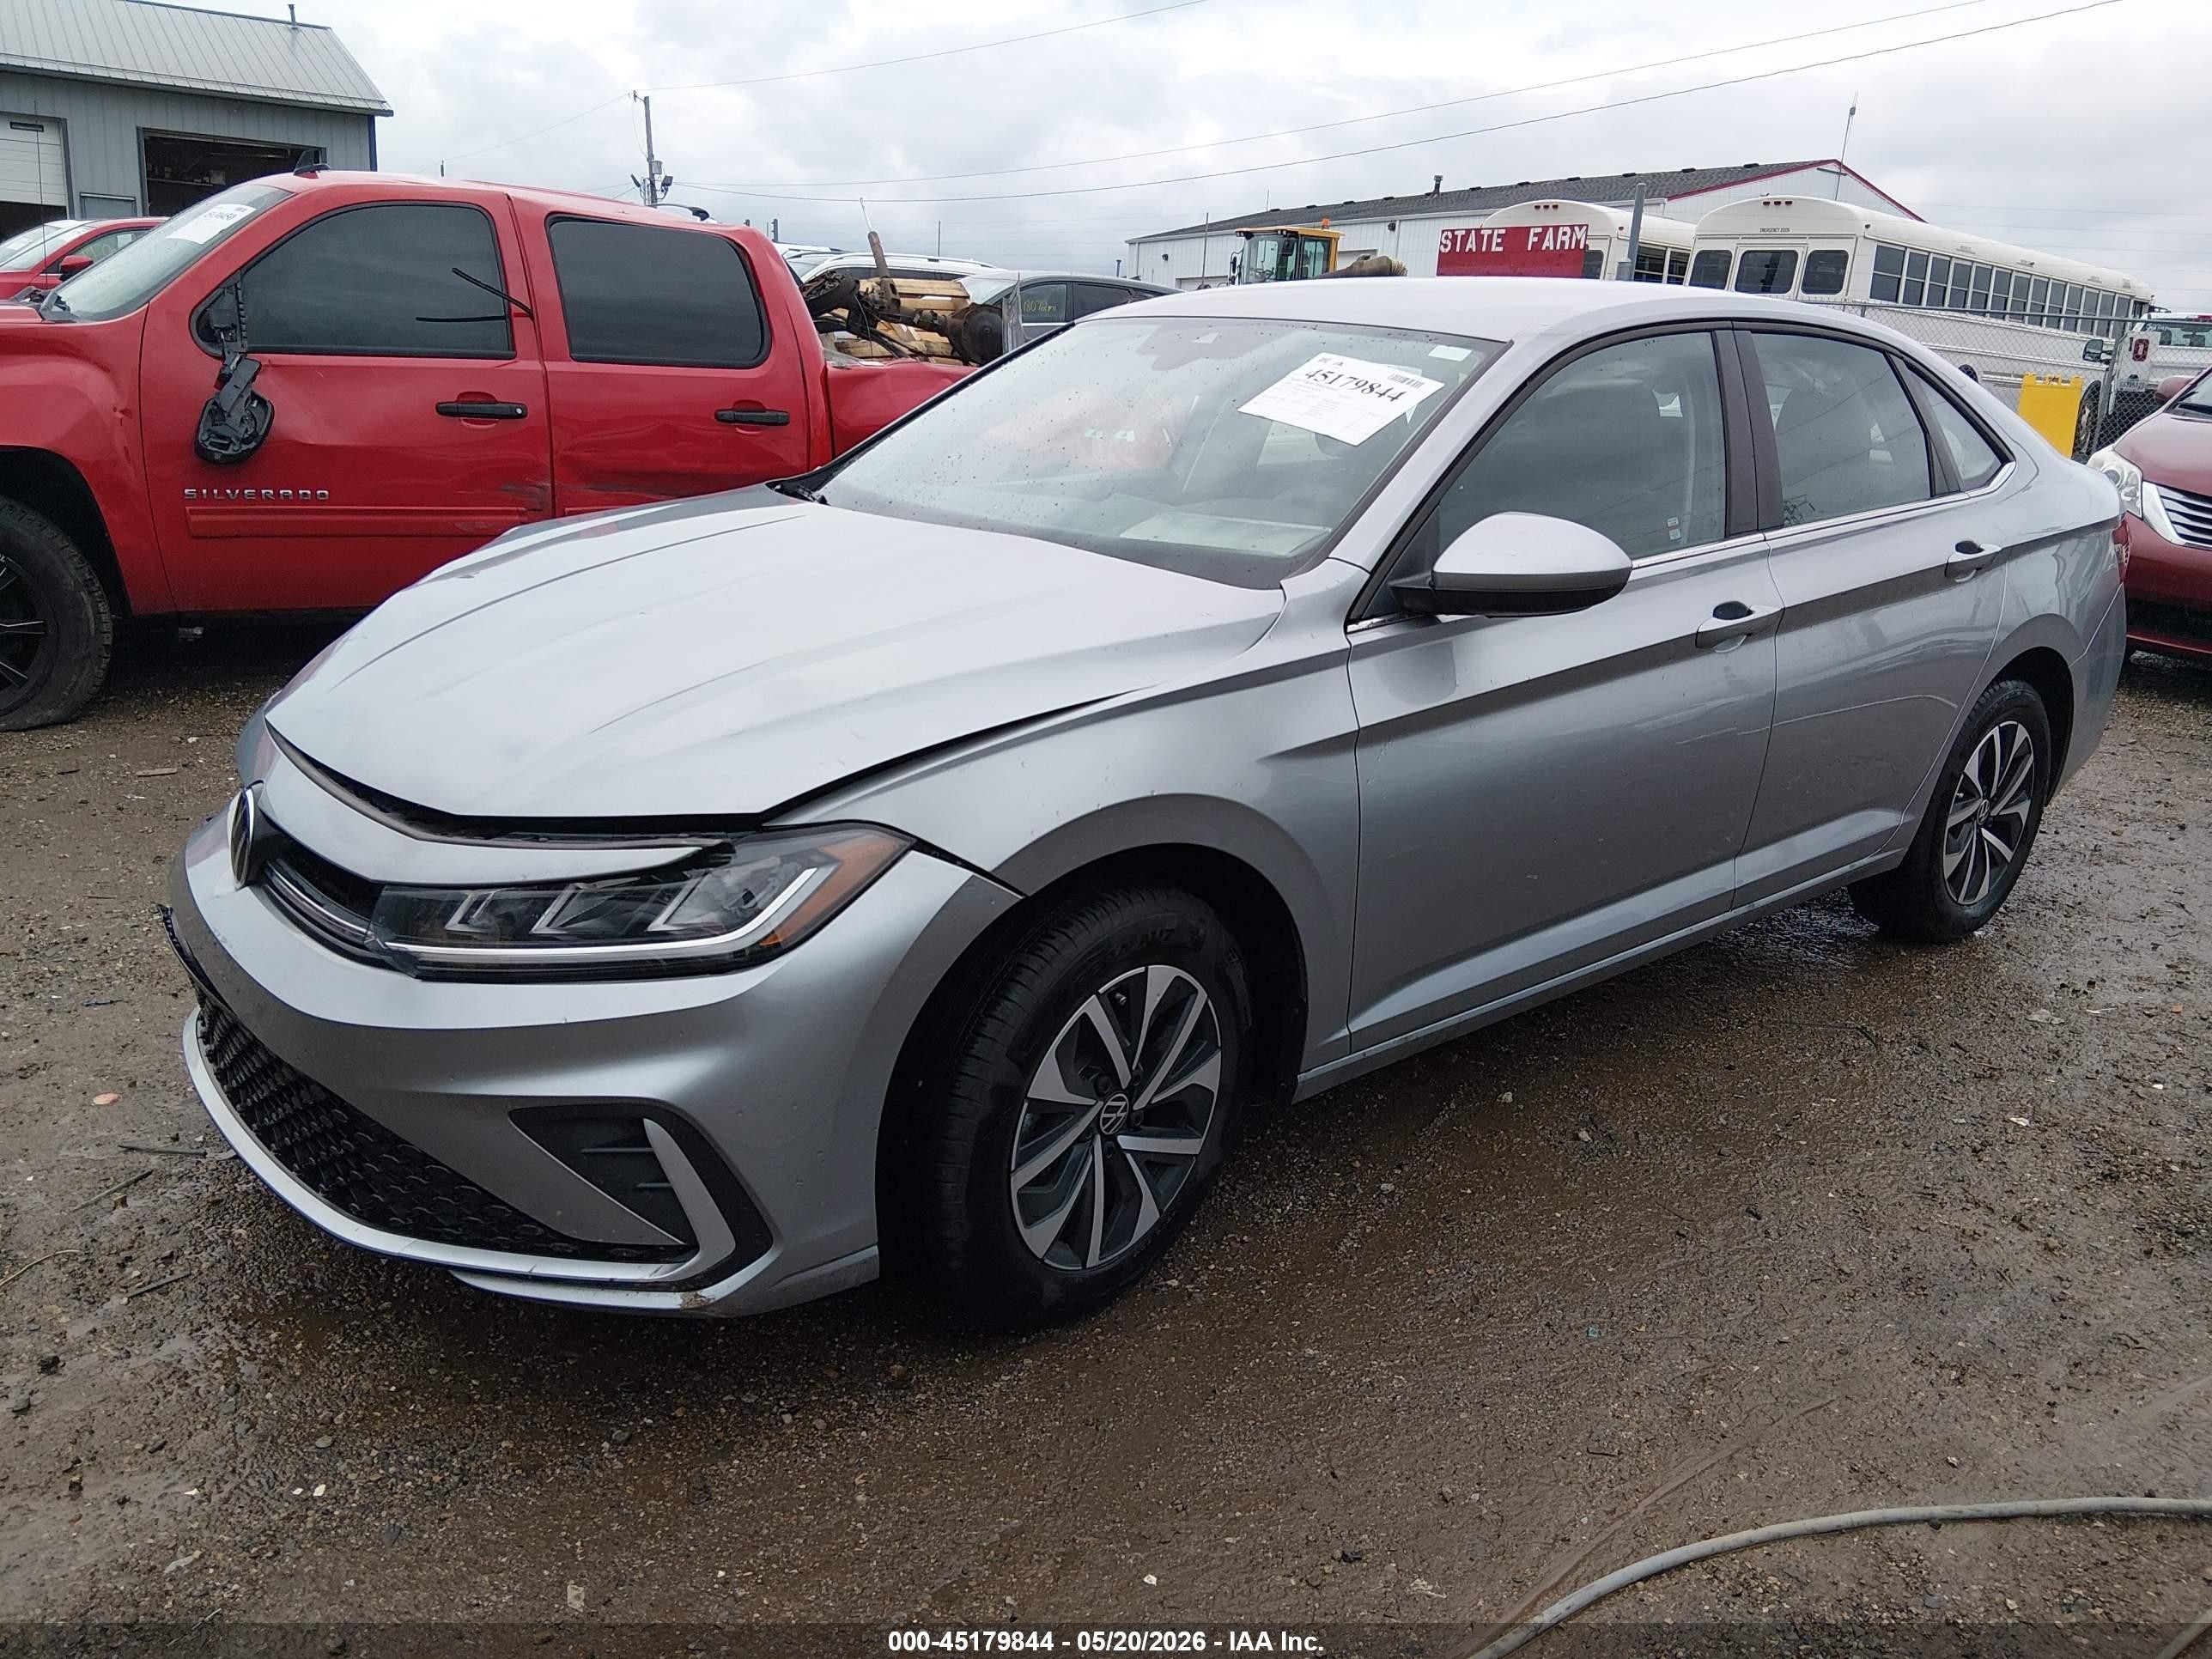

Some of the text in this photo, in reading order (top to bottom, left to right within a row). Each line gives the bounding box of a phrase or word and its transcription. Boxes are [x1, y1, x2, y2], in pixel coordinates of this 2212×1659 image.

[1439, 225, 1587, 253] STATE FARM
[1305, 368, 1407, 402] 45179844
[184, 489, 330, 501] SILVERADO
